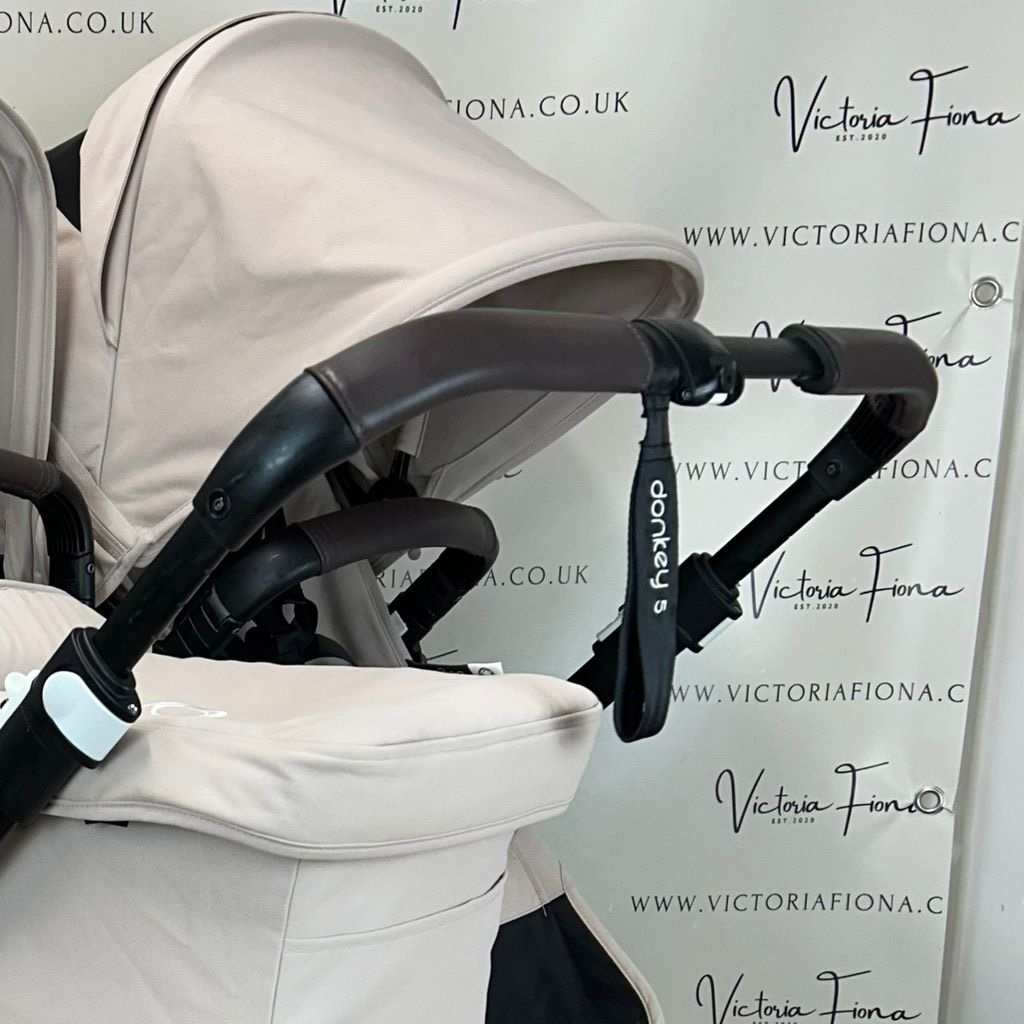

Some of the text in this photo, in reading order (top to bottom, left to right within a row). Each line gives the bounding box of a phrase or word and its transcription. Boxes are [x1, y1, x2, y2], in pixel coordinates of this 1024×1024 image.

[447, 91, 630, 121] IONA.CO.UK
[773, 66, 1021, 155] Victoria Fiona
[682, 221, 1021, 248] WWW.VICTORIAFIONA.C
[649, 479, 671, 614] donkey 5
[859, 543, 965, 624] Fiona
[715, 768, 834, 834] Victoria
[631, 892, 944, 915] WWW.VICTORIAFIONA.C
